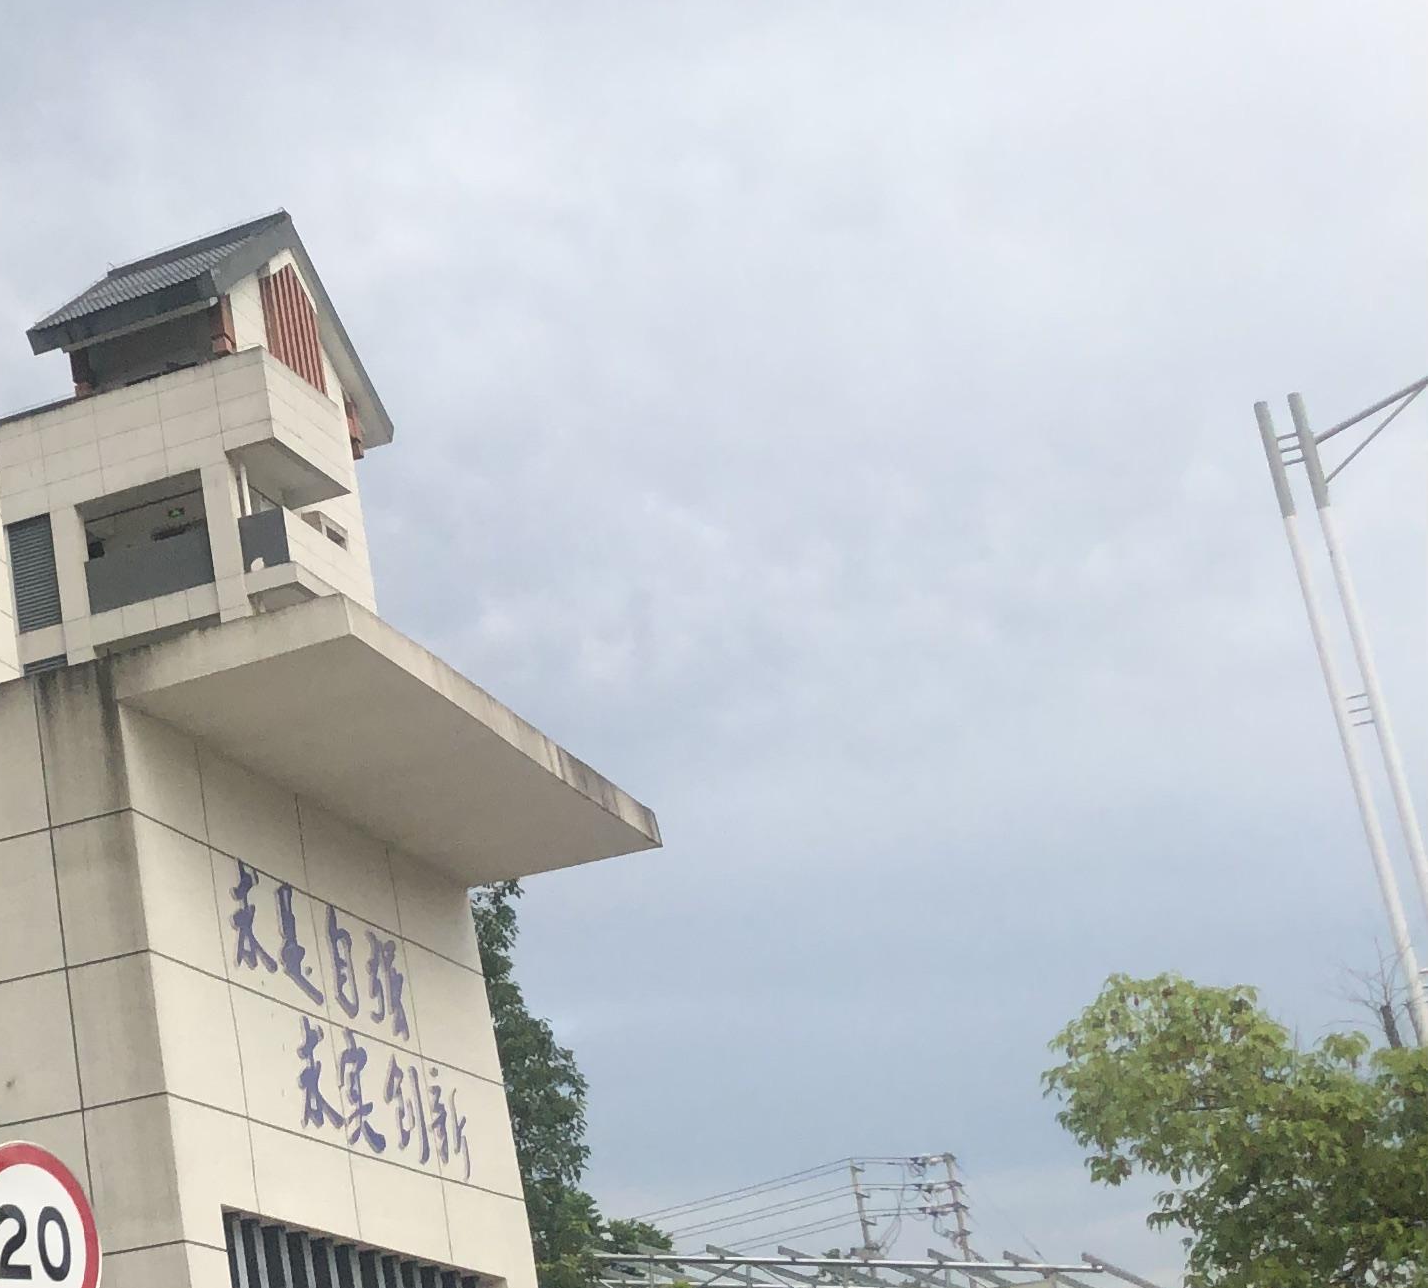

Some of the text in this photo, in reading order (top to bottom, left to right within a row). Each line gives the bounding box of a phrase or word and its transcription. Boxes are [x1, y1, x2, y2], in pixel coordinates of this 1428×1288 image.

[229, 857, 411, 1041] 求是自强
[297, 1015, 471, 1182] 求实创新
